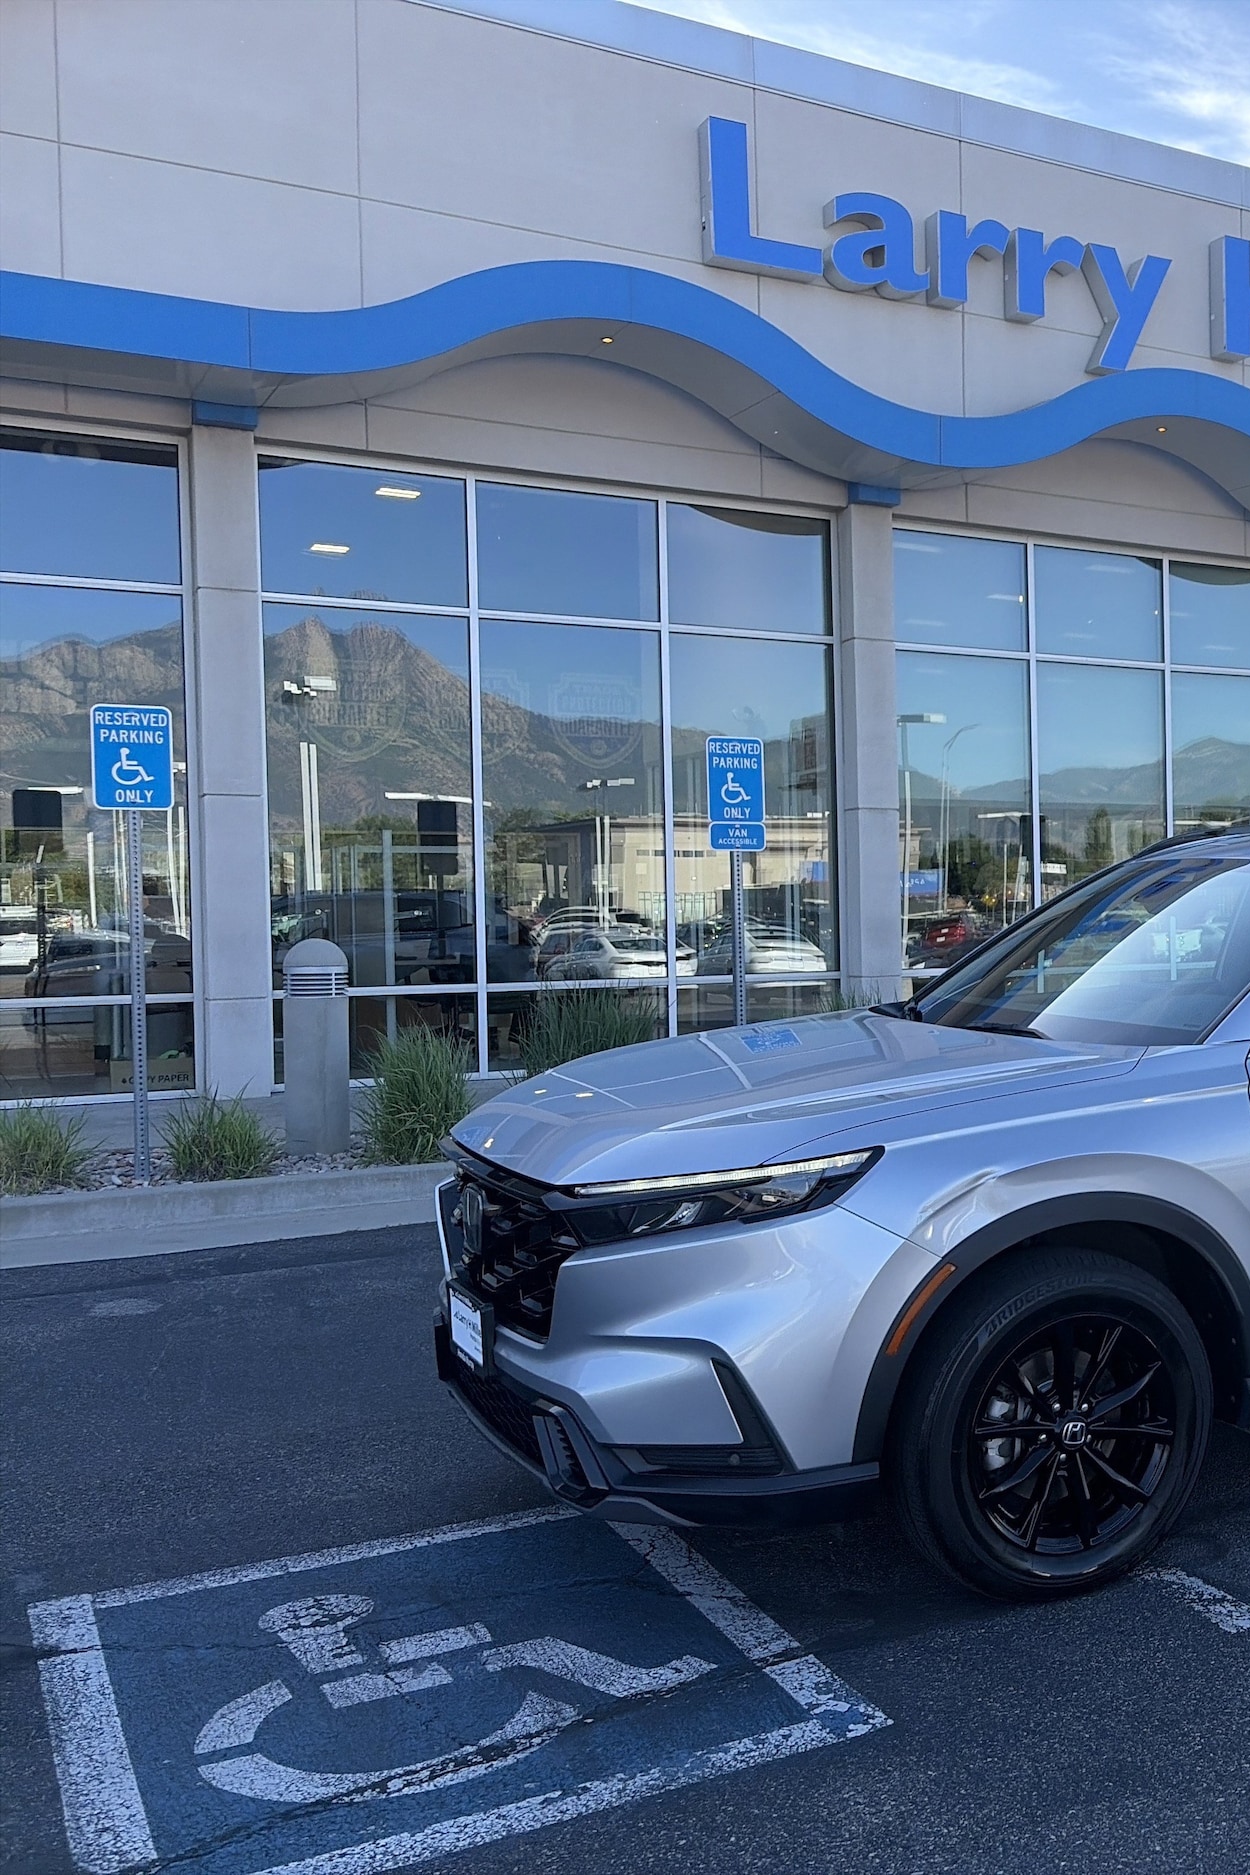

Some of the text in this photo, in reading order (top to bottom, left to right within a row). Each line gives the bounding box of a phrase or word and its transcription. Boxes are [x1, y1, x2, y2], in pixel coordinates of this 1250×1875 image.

[698, 115, 1172, 376] Larry
[94, 711, 168, 728] RESERVED
[99, 729, 164, 745] PARKING
[708, 741, 761, 755] RESERVED
[712, 756, 759, 770] PARKING
[115, 788, 154, 804] ONLY
[723, 806, 751, 819] ONLY
[728, 827, 748, 838] VAN
[717, 837, 758, 846] ACCESSIBLE
[157, 1073, 190, 1084] PAPER
